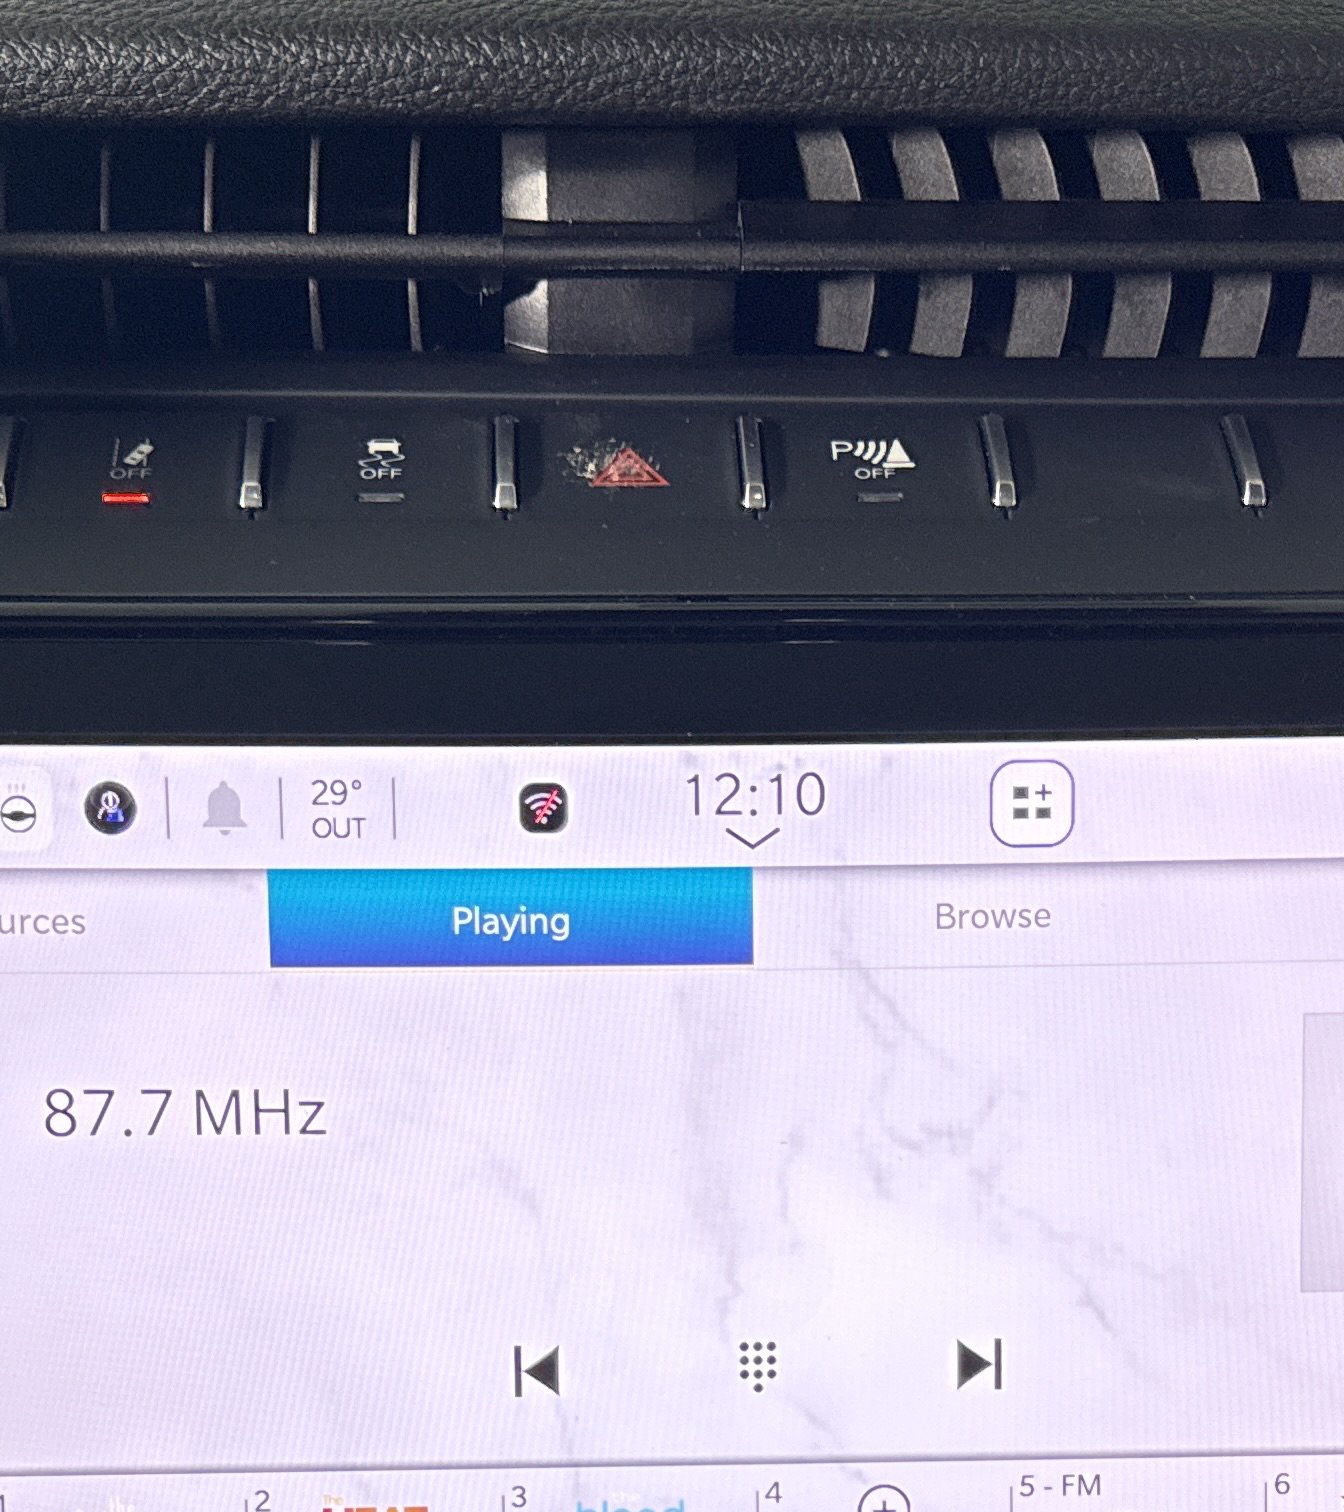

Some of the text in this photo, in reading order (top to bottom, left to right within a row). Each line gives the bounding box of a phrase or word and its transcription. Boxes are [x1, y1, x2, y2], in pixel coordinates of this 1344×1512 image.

[831, 440, 854, 461] P
[109, 467, 154, 479] OFF
[359, 467, 403, 480] OFF
[854, 467, 897, 480] OFF
[310, 779, 362, 806] 29°
[686, 772, 826, 816] 12:10
[312, 818, 366, 839] OUT
[453, 905, 570, 941] Playing
[936, 902, 1051, 930] Browse
[44, 1088, 327, 1137] 87.7 MHz
[765, 1482, 783, 1504] 4
[1019, 1475, 1035, 1497] 5
[1061, 1474, 1102, 1497] FM
[1274, 1473, 1290, 1495] 6
[254, 1490, 271, 1512] 2
[511, 1486, 527, 1508] 3
